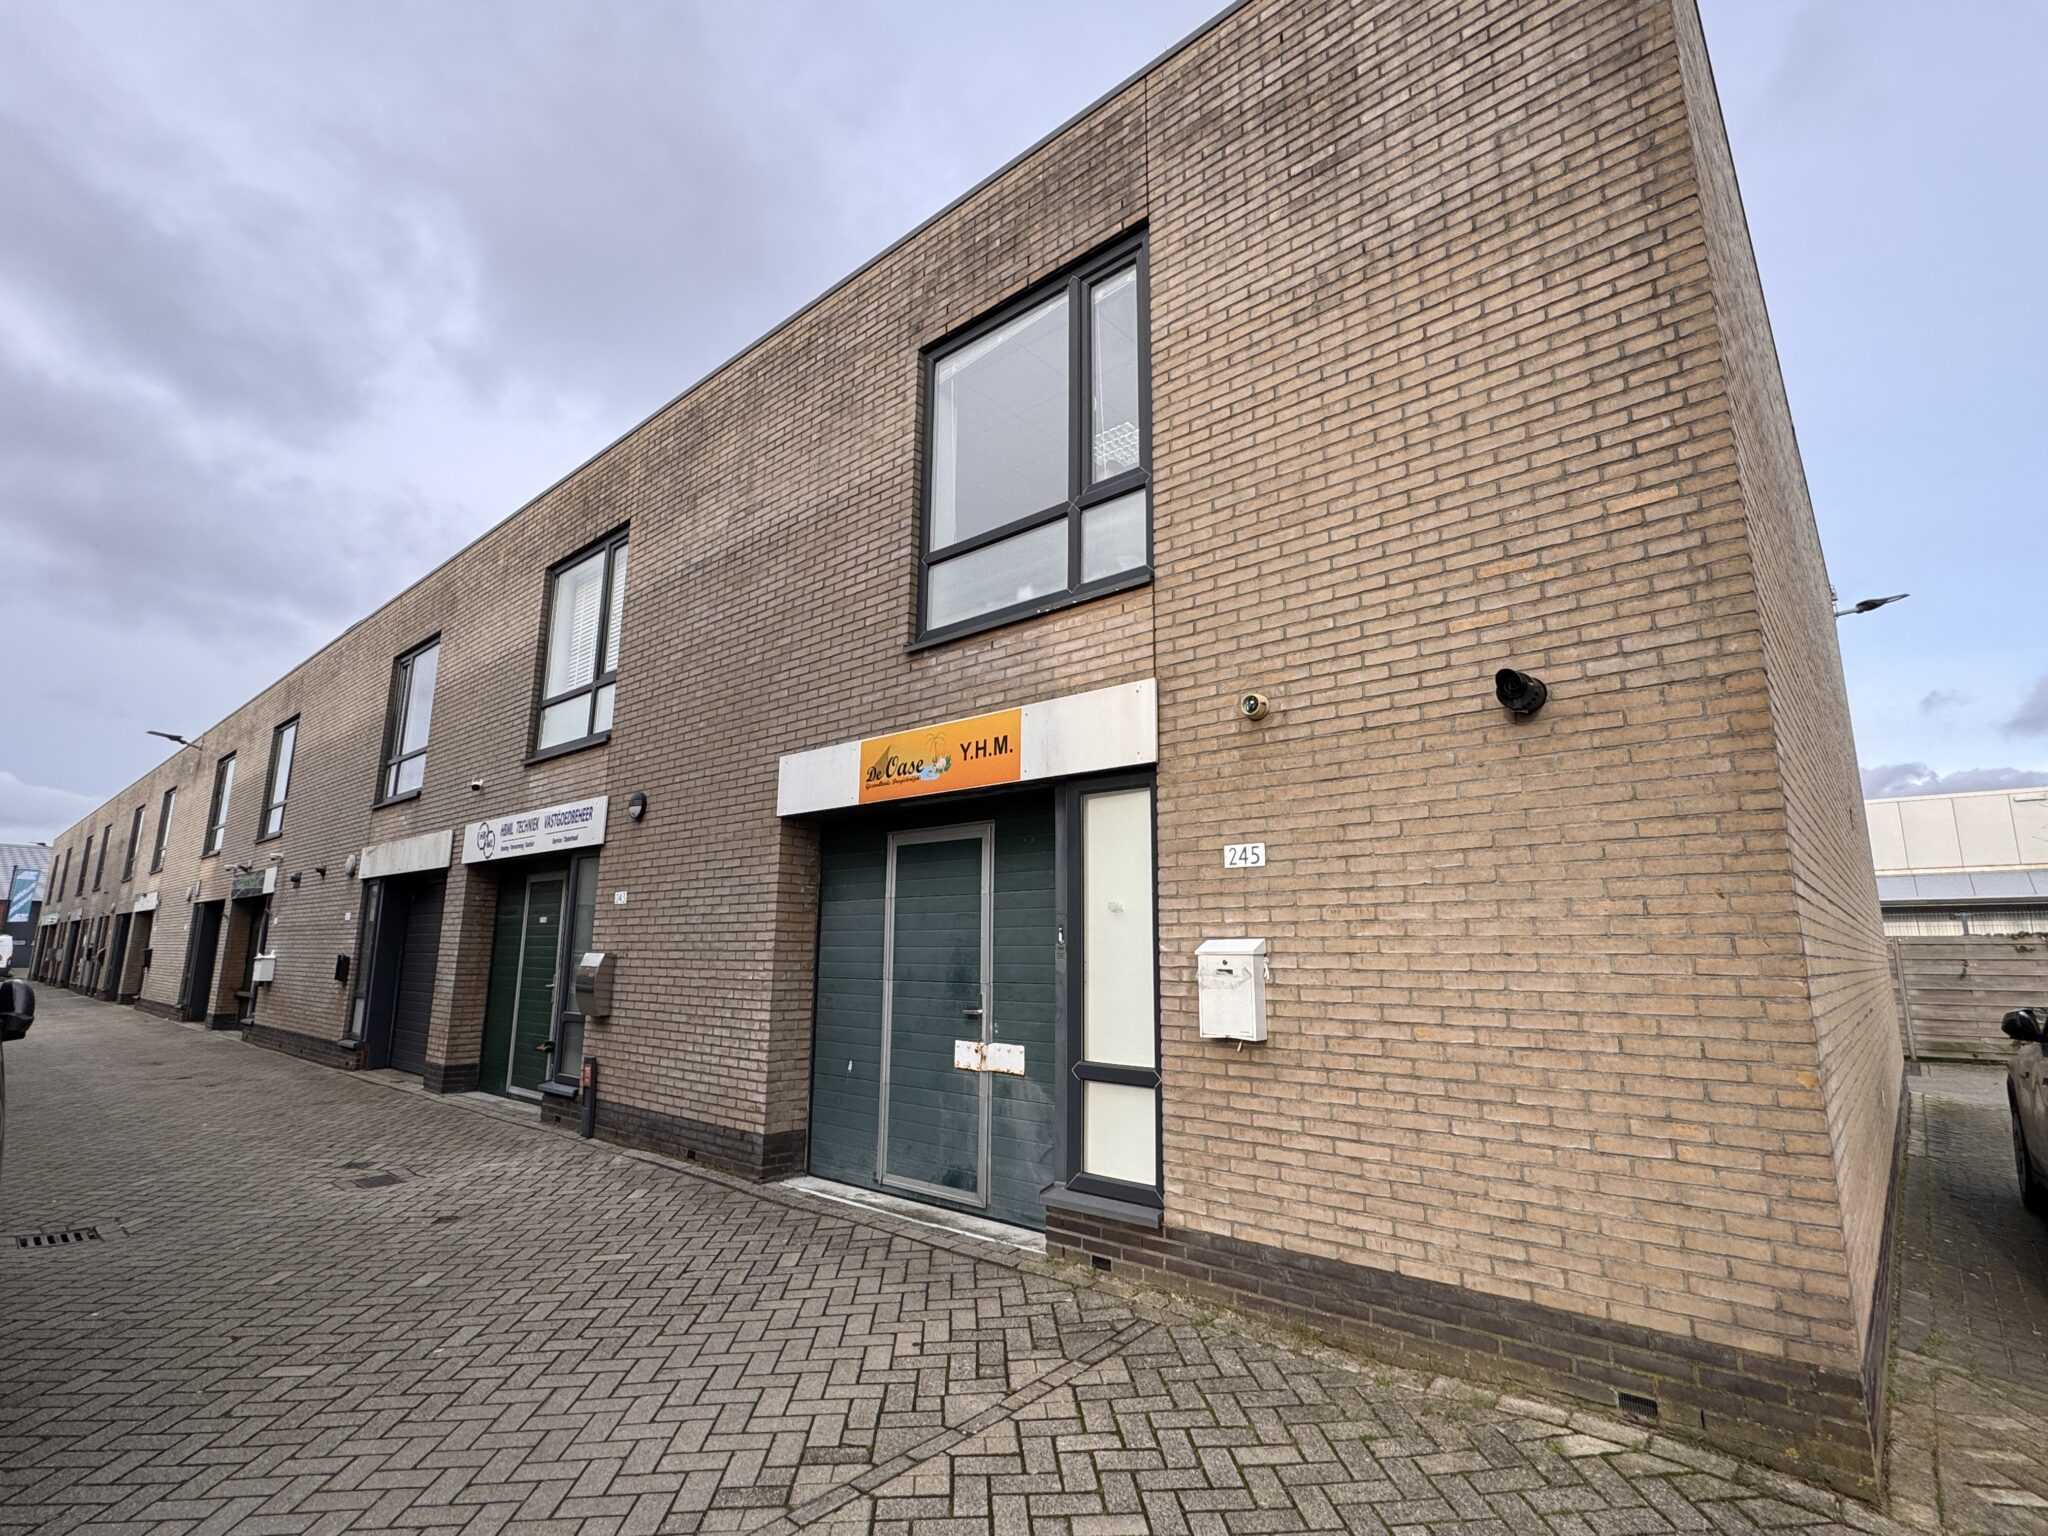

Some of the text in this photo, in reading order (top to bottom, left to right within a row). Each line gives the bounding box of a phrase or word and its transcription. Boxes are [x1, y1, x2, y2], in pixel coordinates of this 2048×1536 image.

[960, 735, 1013, 761] Y.H.M.
[866, 755, 924, 782] De Oase
[516, 817, 540, 832] TECHNIEK
[544, 807, 593, 829] VASTGOEDBEHEER
[1229, 845, 1260, 865] 245
